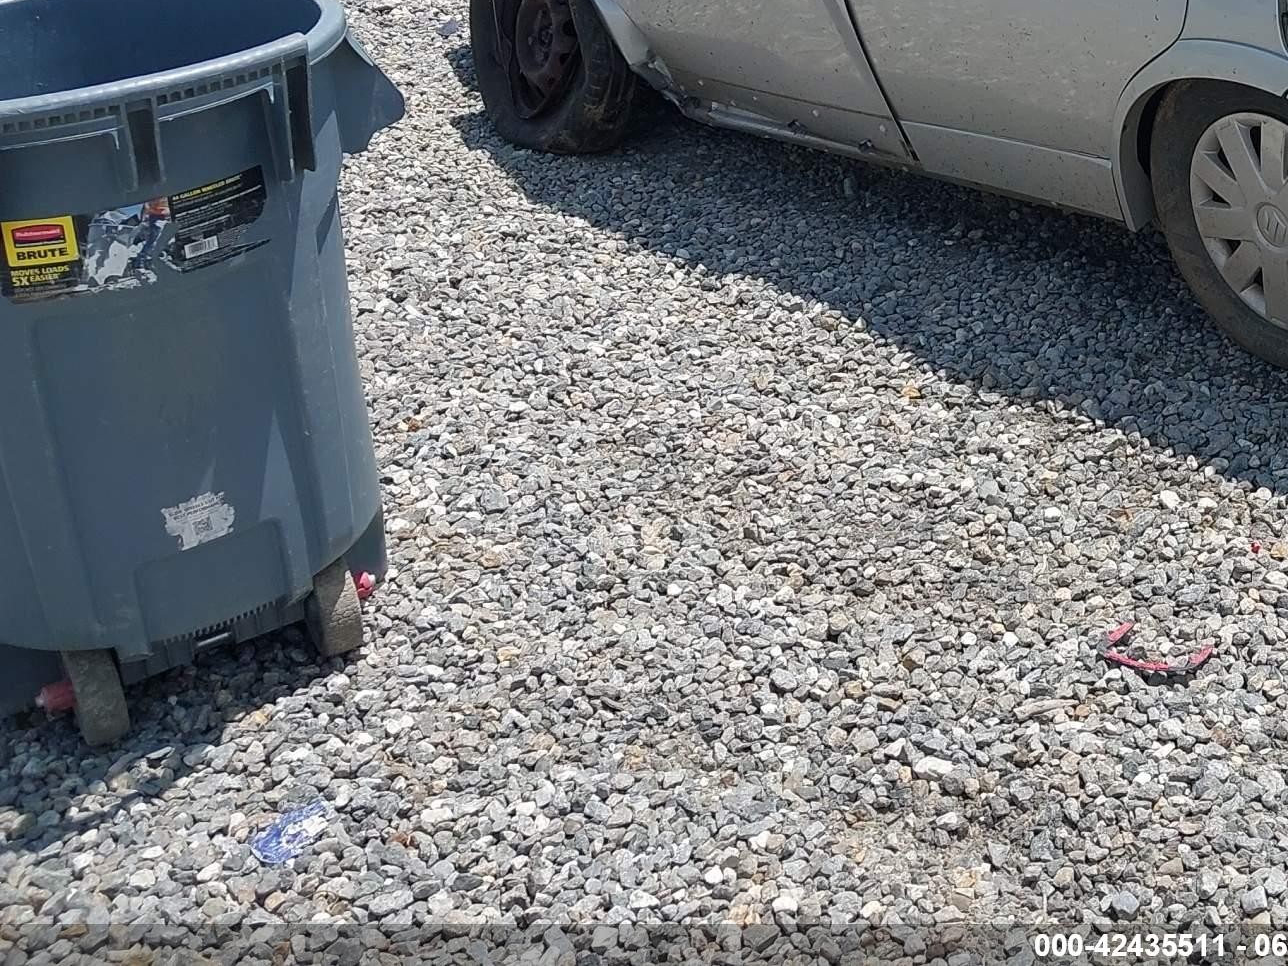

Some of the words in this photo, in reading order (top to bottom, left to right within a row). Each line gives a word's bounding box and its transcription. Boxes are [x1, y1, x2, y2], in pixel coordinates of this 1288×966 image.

[16, 247, 70, 261] BRUTE
[10, 267, 41, 278] MOVES
[42, 264, 70, 275] LOADS
[12, 276, 30, 287] 5X
